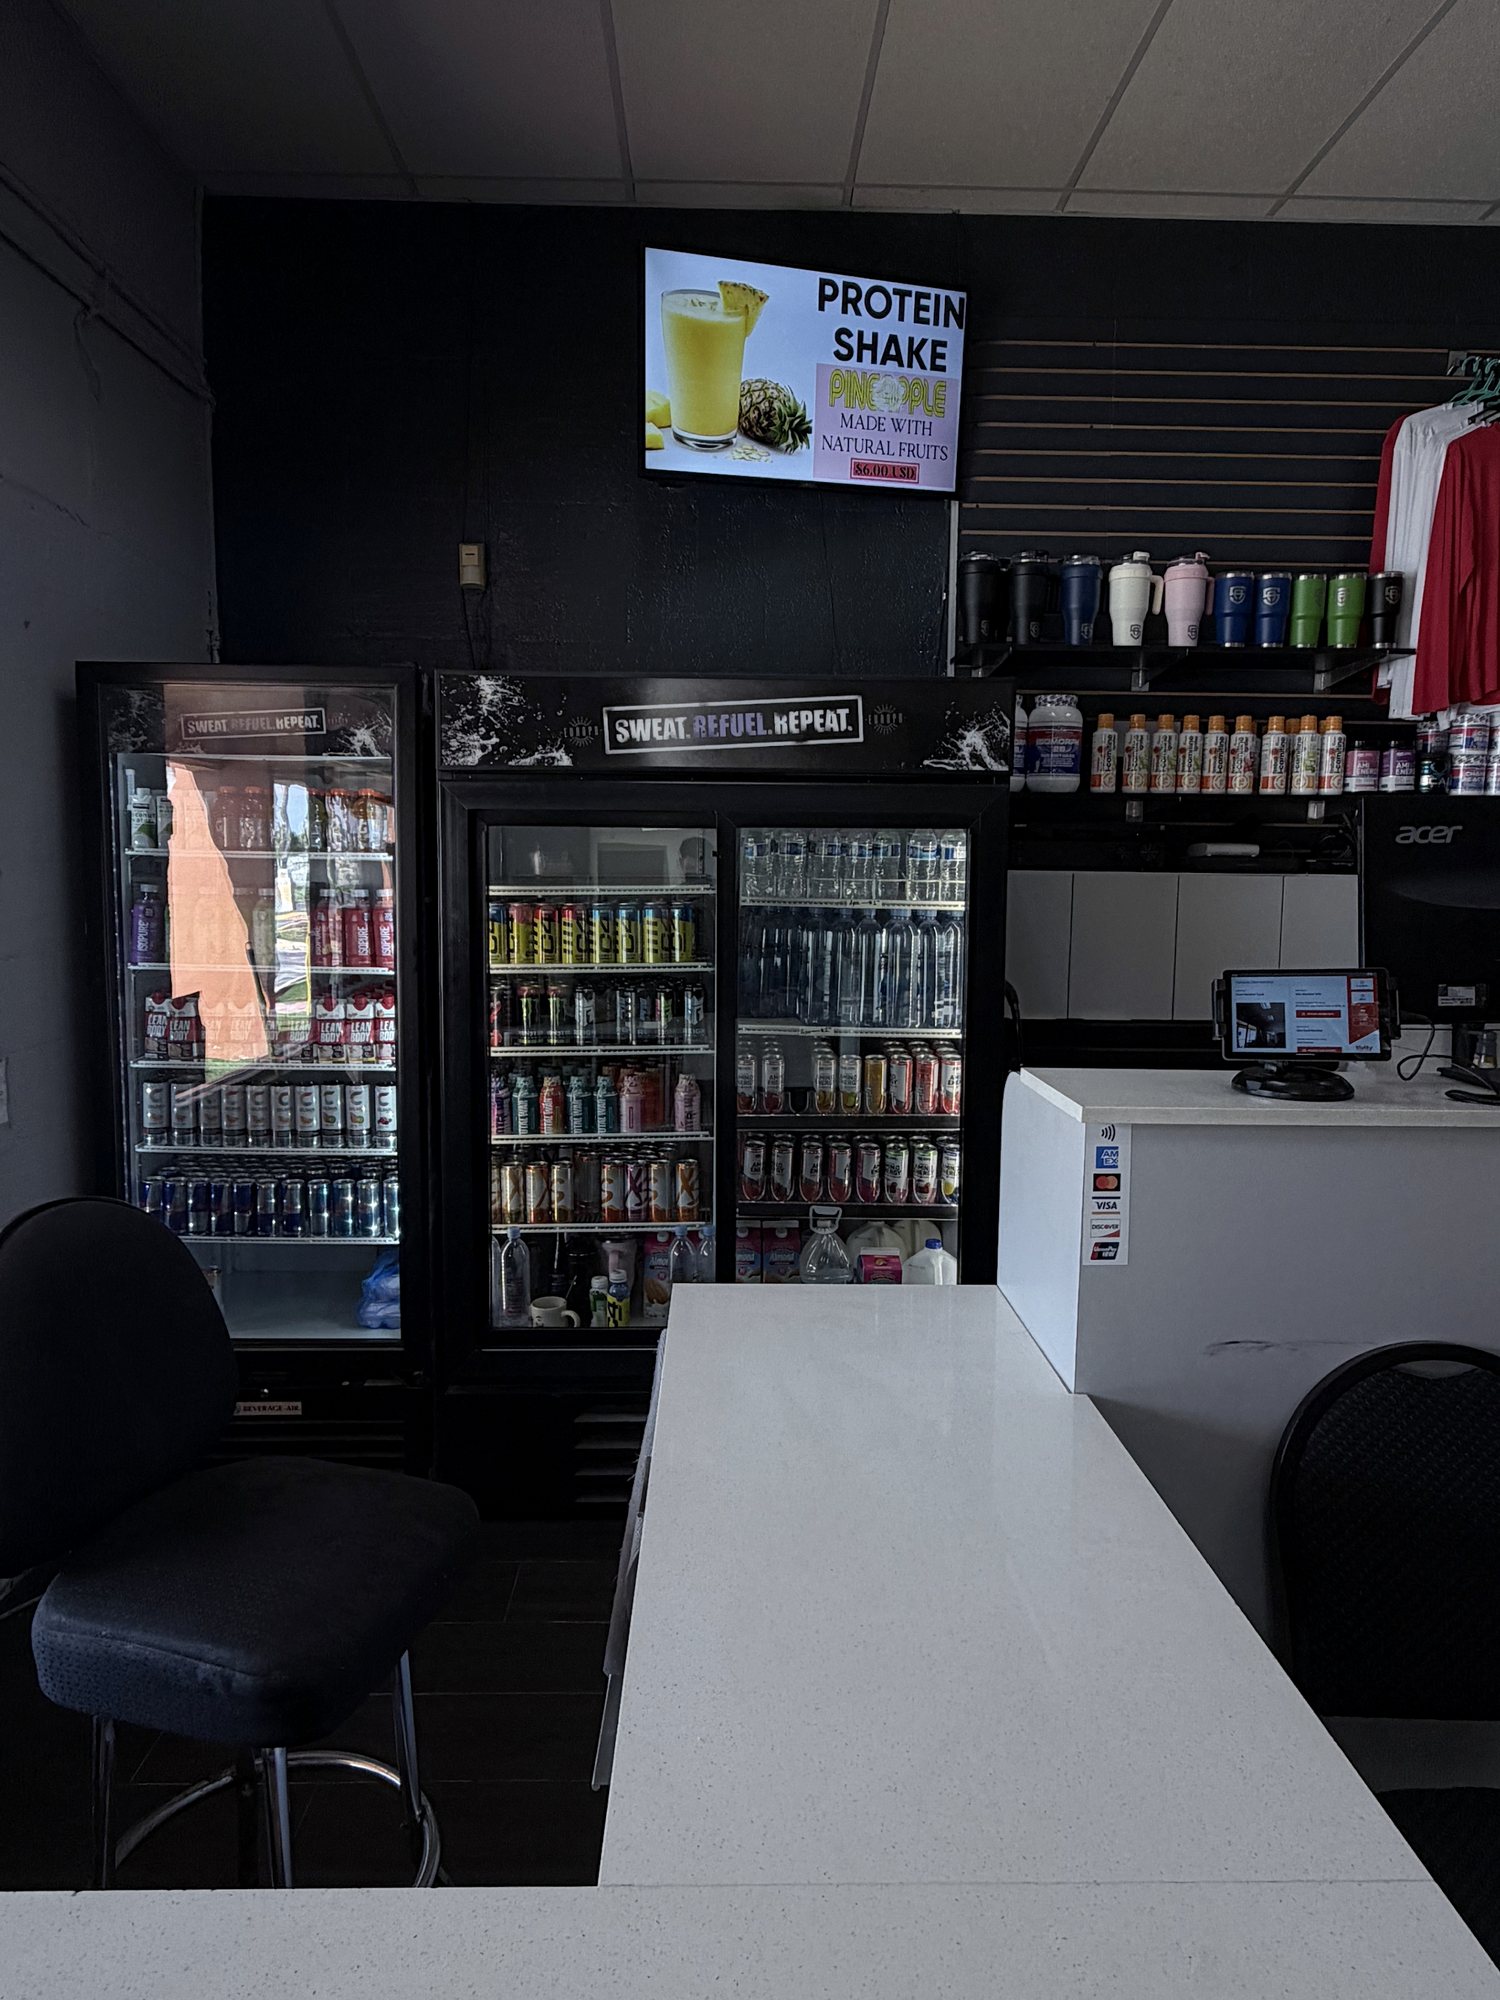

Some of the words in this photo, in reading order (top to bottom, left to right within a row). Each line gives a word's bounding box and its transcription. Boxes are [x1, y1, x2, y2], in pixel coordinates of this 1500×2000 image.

[817, 277, 965, 330] PROTEIN
[833, 327, 947, 372] SHAKE
[840, 413, 886, 432] MADE
[890, 417, 932, 437] WITH
[822, 435, 895, 456] NATURAL
[899, 442, 948, 461] FRUITS
[855, 462, 888, 477] $6.00
[891, 465, 915, 480] USD
[1396, 826, 1463, 844] acer
[137, 920, 149, 952] ISOPURE
[358, 925, 369, 956] ISOPURE
[379, 925, 391, 956] ISOPURE
[147, 1013, 168, 1025] LEAN
[169, 1019, 190, 1030] LEAN
[380, 1021, 395, 1031] LEA
[321, 1022, 342, 1032] LEAN
[351, 1022, 371, 1032] LEAN
[320, 1032, 341, 1043] BODY
[351, 1032, 370, 1043] BODY
[379, 1031, 395, 1042] BOD
[1095, 1201, 1118, 1210] VISA
